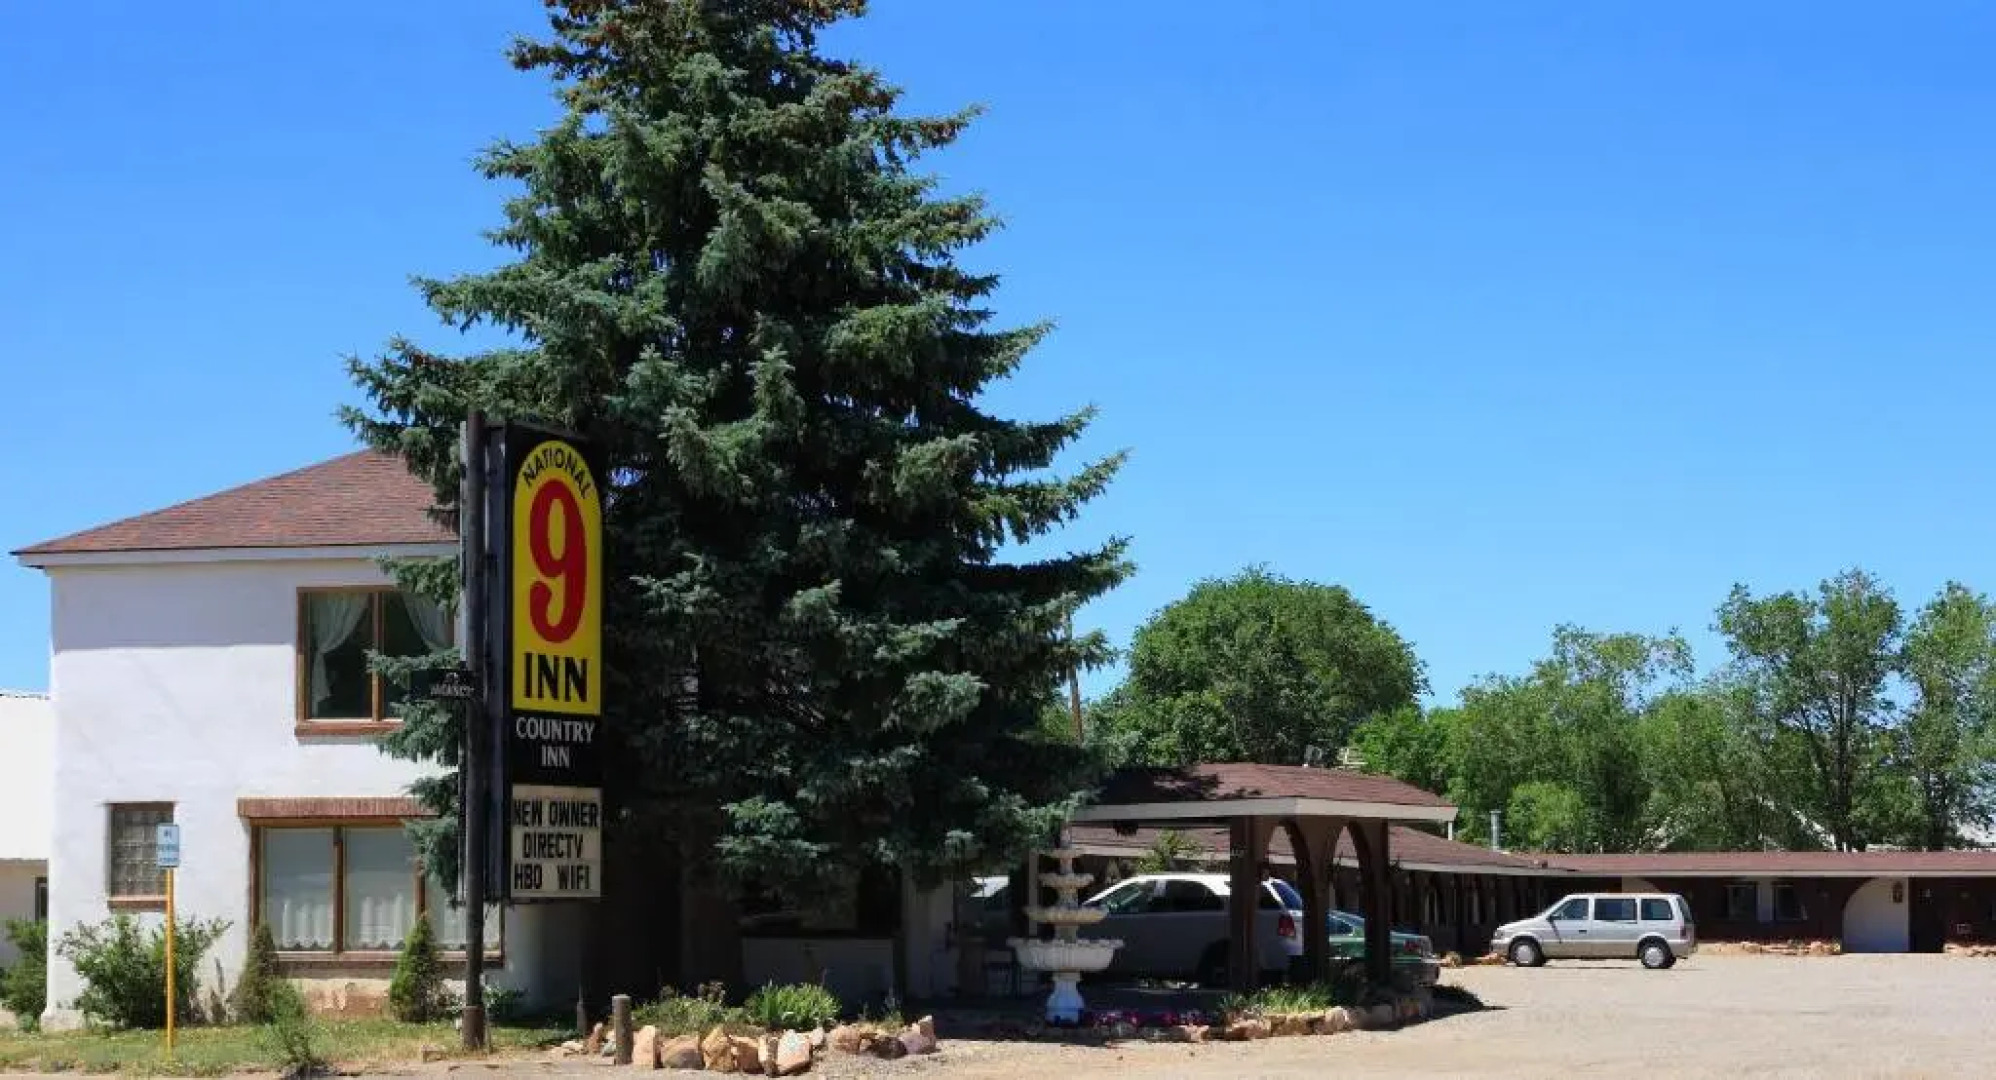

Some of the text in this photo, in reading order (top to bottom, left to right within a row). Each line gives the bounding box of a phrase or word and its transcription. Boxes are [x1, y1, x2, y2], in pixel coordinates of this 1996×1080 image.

[522, 446, 592, 499] NATIONAL
[530, 479, 587, 643] 9
[524, 652, 588, 703] INN
[516, 717, 595, 743] COUNTRY
[541, 745, 570, 767] INN
[512, 799, 599, 828] NEW OWNER
[523, 832, 584, 859] DIRECTV
[514, 863, 590, 890] HBO WIFI
